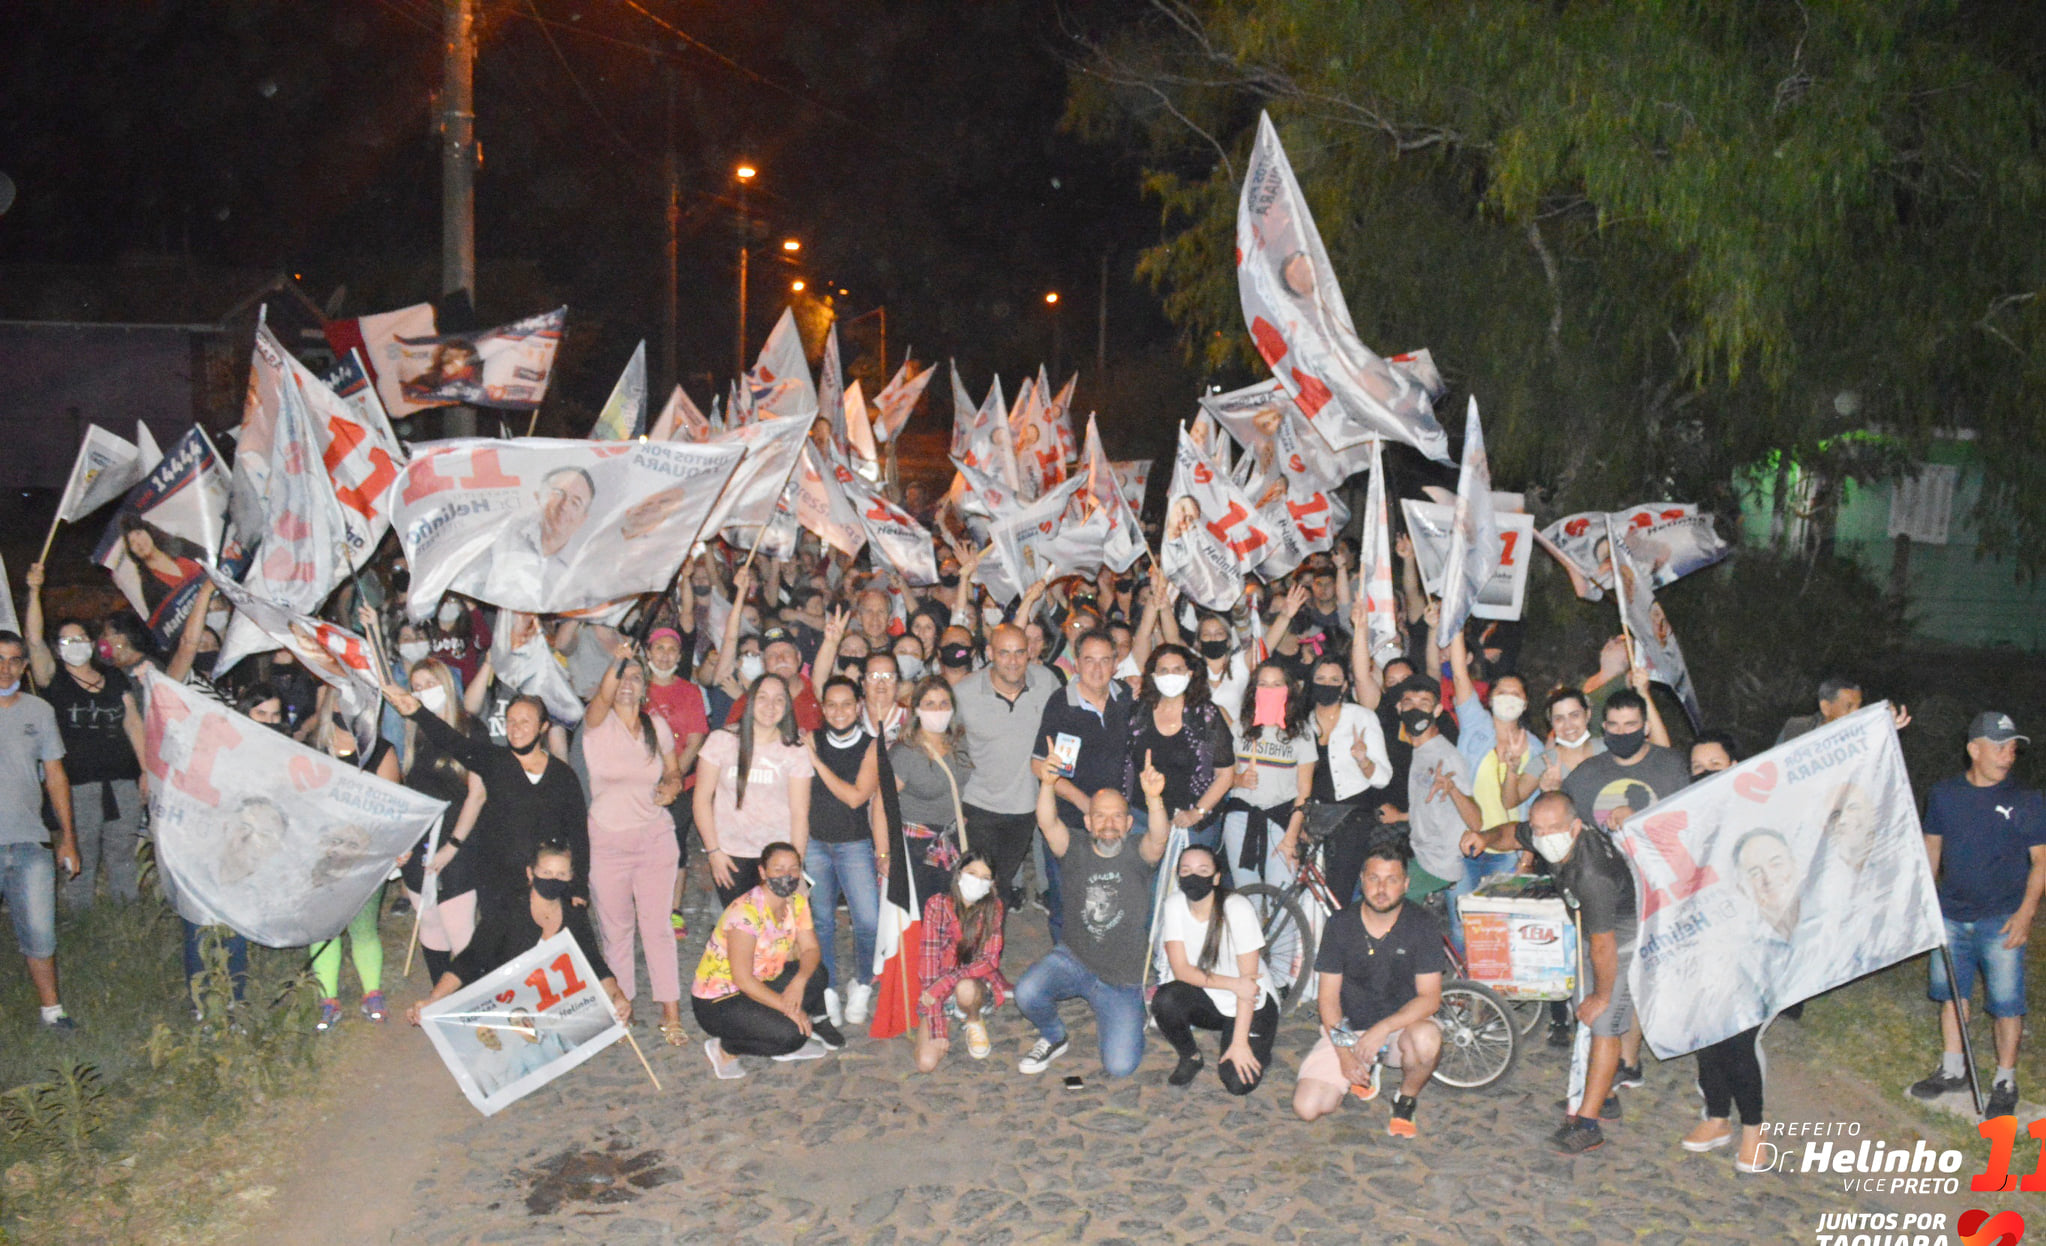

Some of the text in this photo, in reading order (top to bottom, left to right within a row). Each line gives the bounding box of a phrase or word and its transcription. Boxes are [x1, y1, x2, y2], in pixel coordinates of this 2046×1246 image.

[151, 441, 202, 492] 14444
[1206, 499, 1269, 562] 11
[1242, 741, 1294, 758] WSTBHVR
[524, 952, 588, 1013] 11
[558, 995, 597, 1017] Helinho
